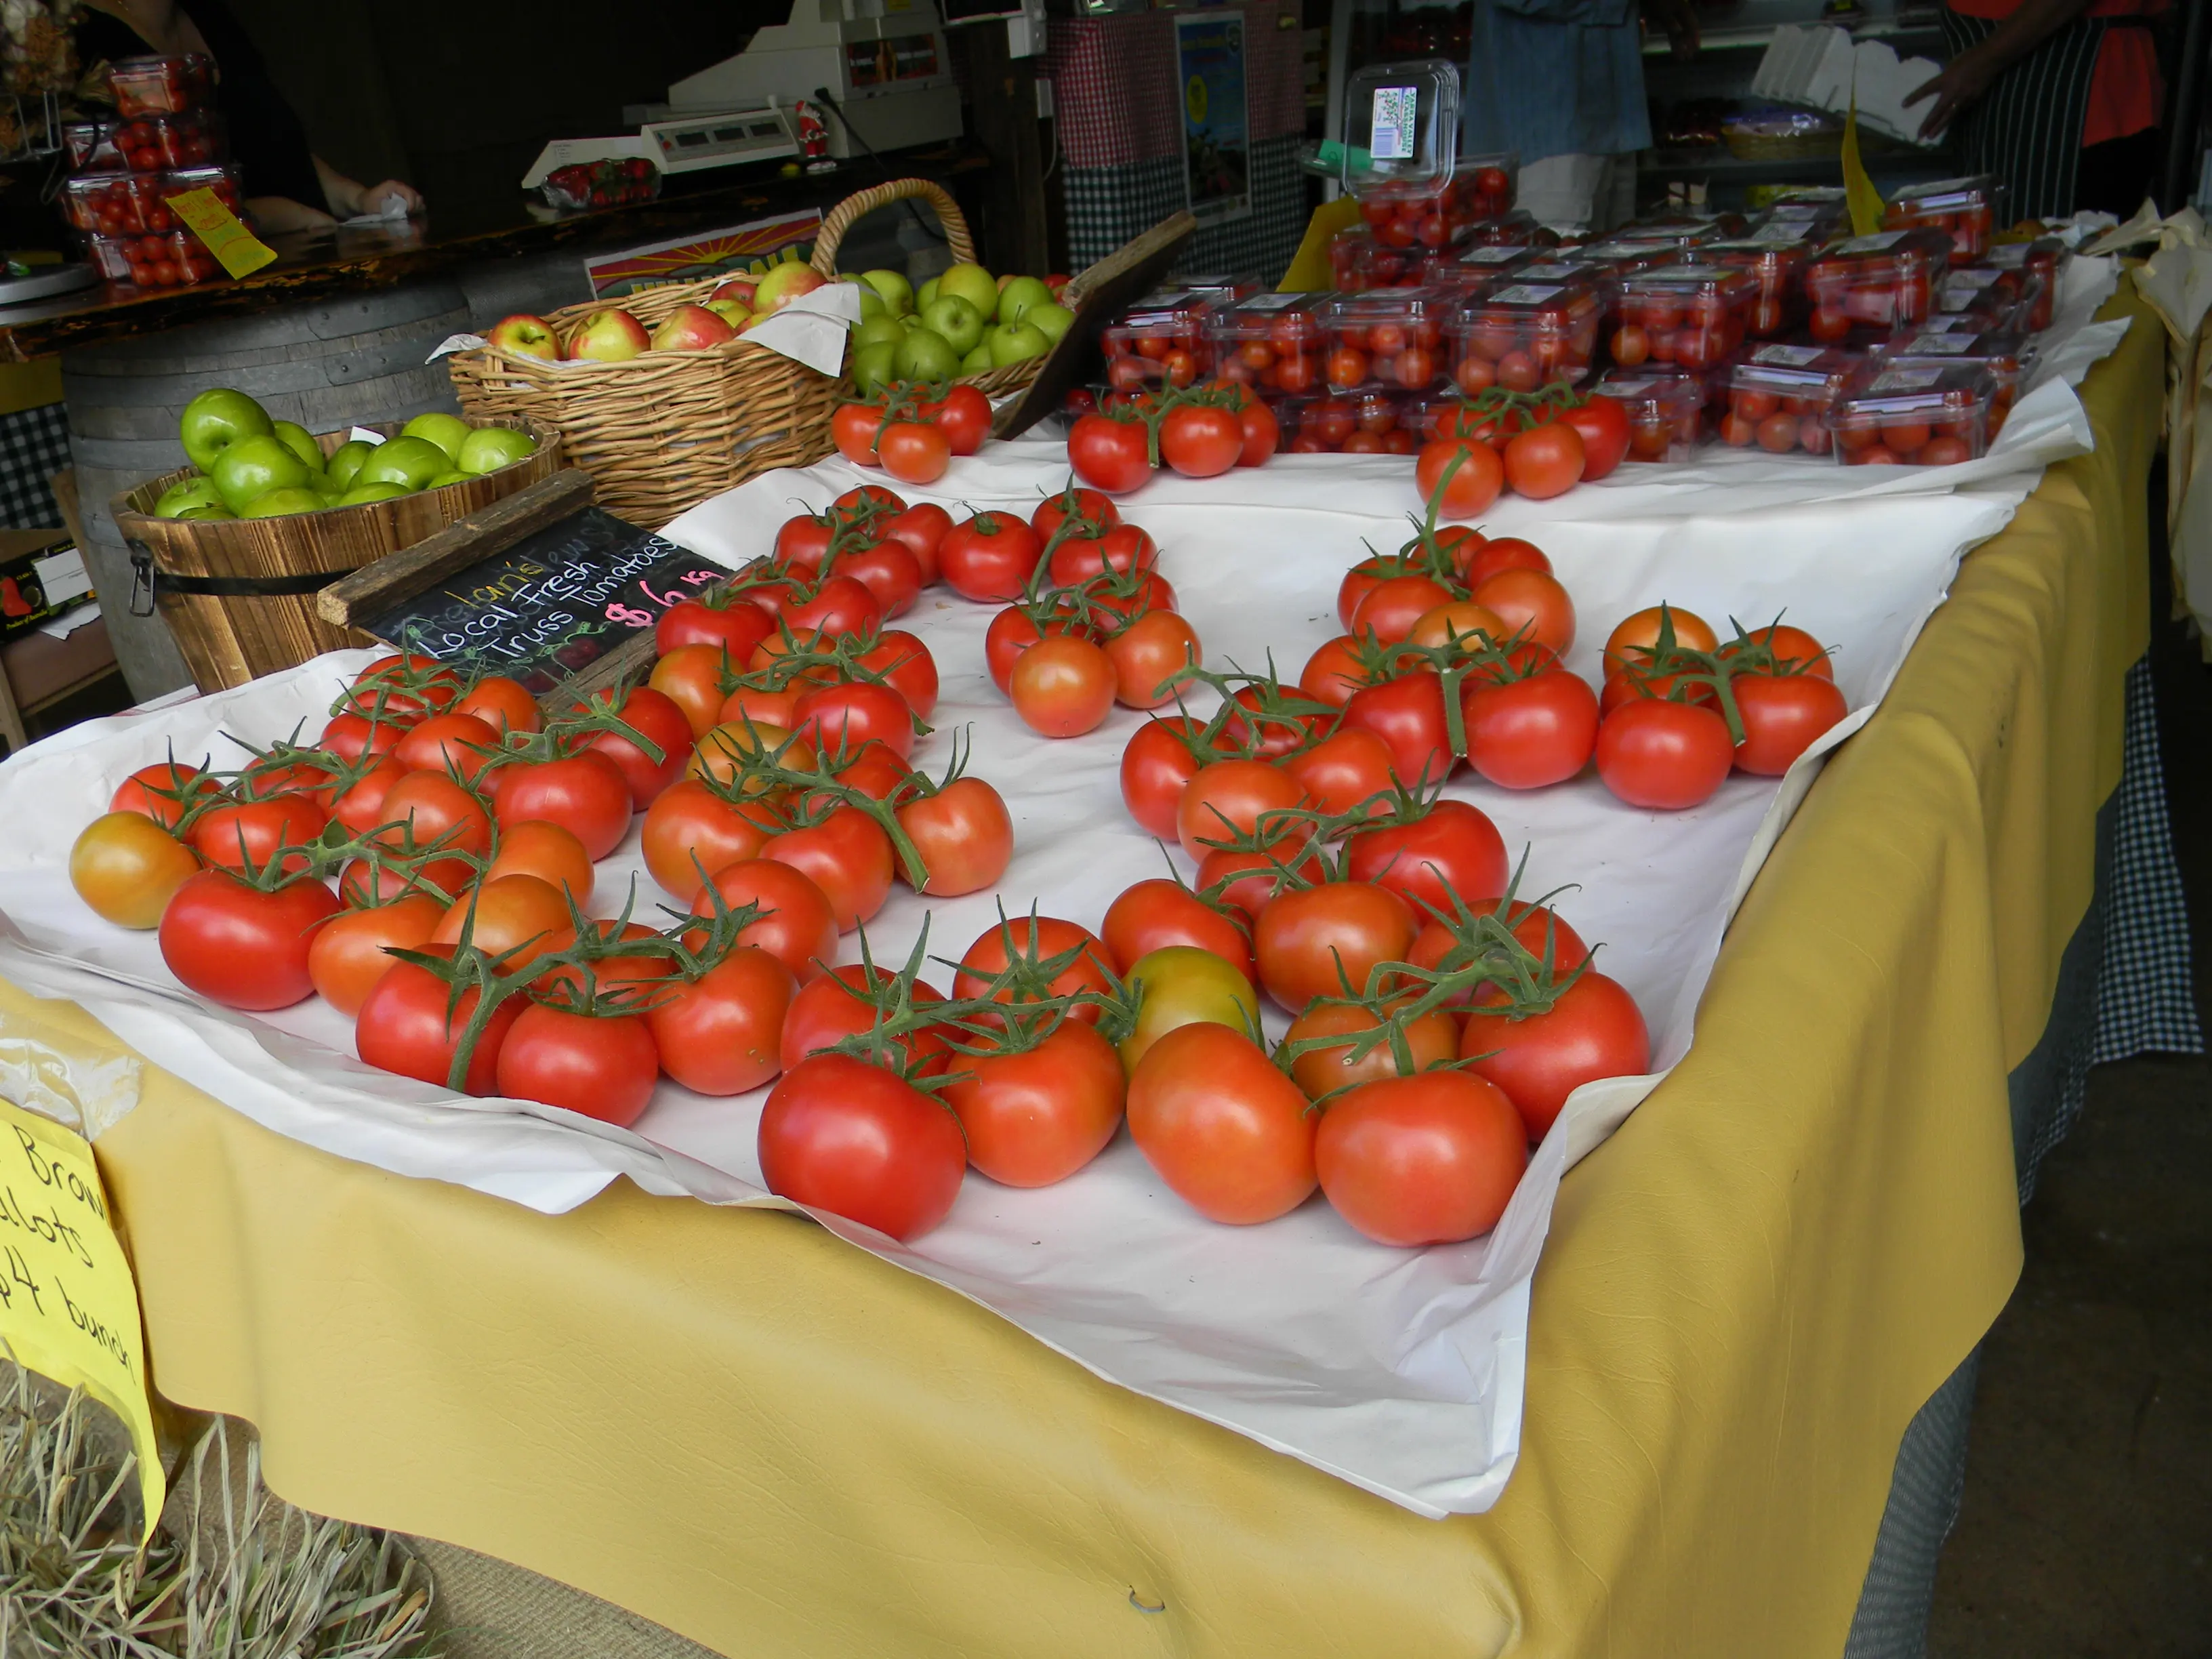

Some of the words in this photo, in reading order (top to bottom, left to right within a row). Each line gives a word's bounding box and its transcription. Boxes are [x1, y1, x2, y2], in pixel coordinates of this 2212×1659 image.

[1402, 94, 1410, 152] GLASSHOUSE
[417, 604, 518, 659] Local
[510, 560, 600, 606] Fresh
[476, 610, 573, 657] Truss
[559, 537, 678, 607] Tomatoes
[12, 1124, 109, 1228] Brow
[0, 1185, 94, 1269] llots
[54, 1275, 137, 1387] bunch
